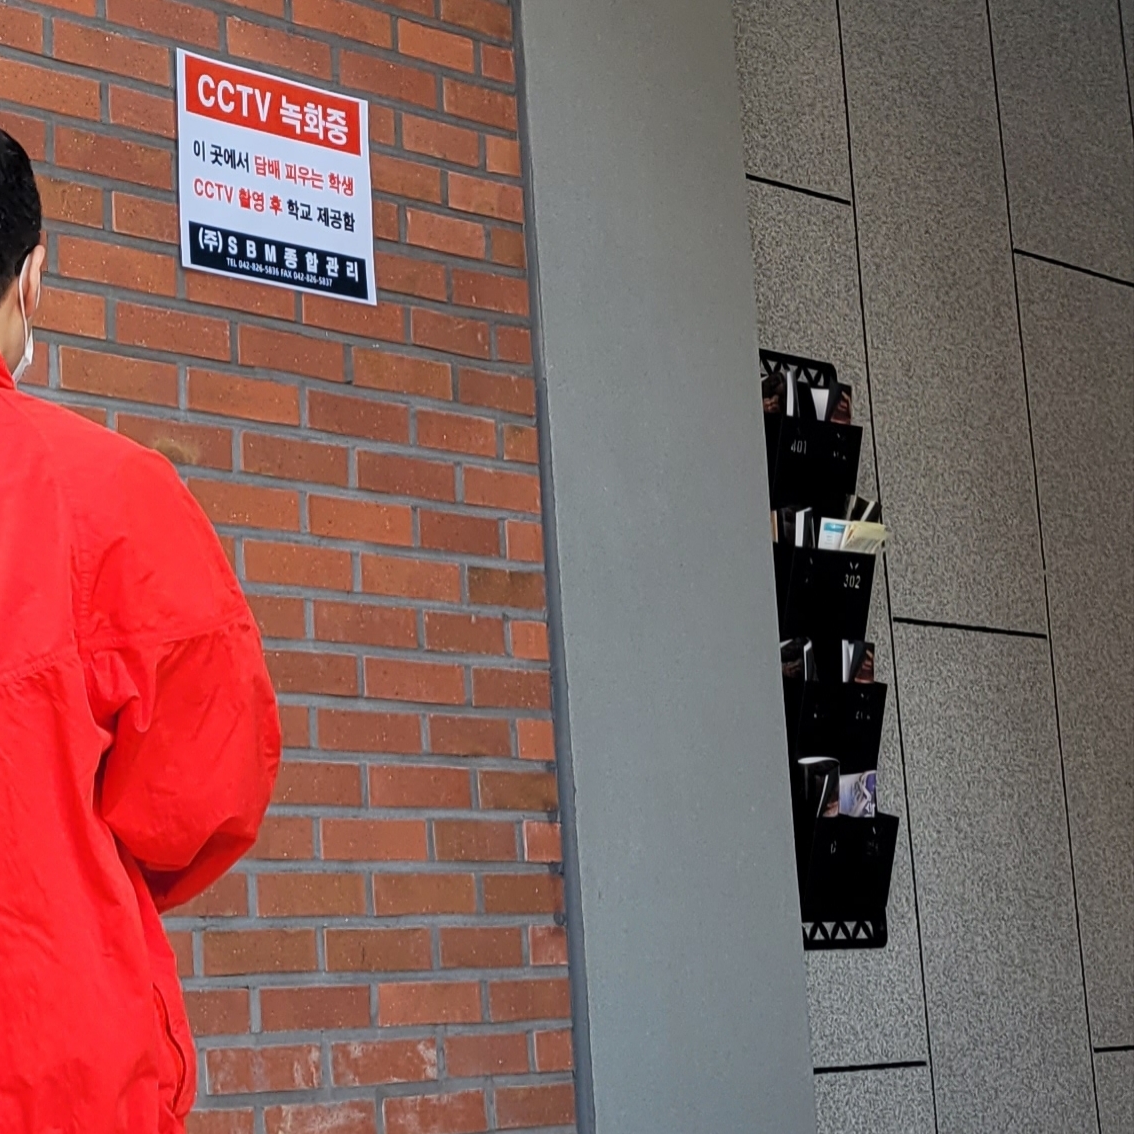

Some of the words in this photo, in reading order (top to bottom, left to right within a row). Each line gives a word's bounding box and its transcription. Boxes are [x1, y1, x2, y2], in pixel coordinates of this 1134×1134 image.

[197, 74, 272, 122] CCTV
[279, 94, 349, 146] 녹화중
[193, 140, 206, 162] 이
[210, 143, 250, 173] 곳에서
[254, 154, 282, 181] 담배
[285, 162, 324, 190] 피우는
[328, 172, 354, 197] 학생
[193, 178, 233, 204] CCTV
[238, 187, 265, 213] 촬영
[269, 194, 283, 216] 후
[286, 198, 313, 222] 학교
[316, 203, 356, 233] 제공함
[226, 257, 237, 268] TEL
[238, 260, 280, 277] 042-826-5836
[280, 268, 293, 279] FAX
[843, 573, 862, 590] 302
